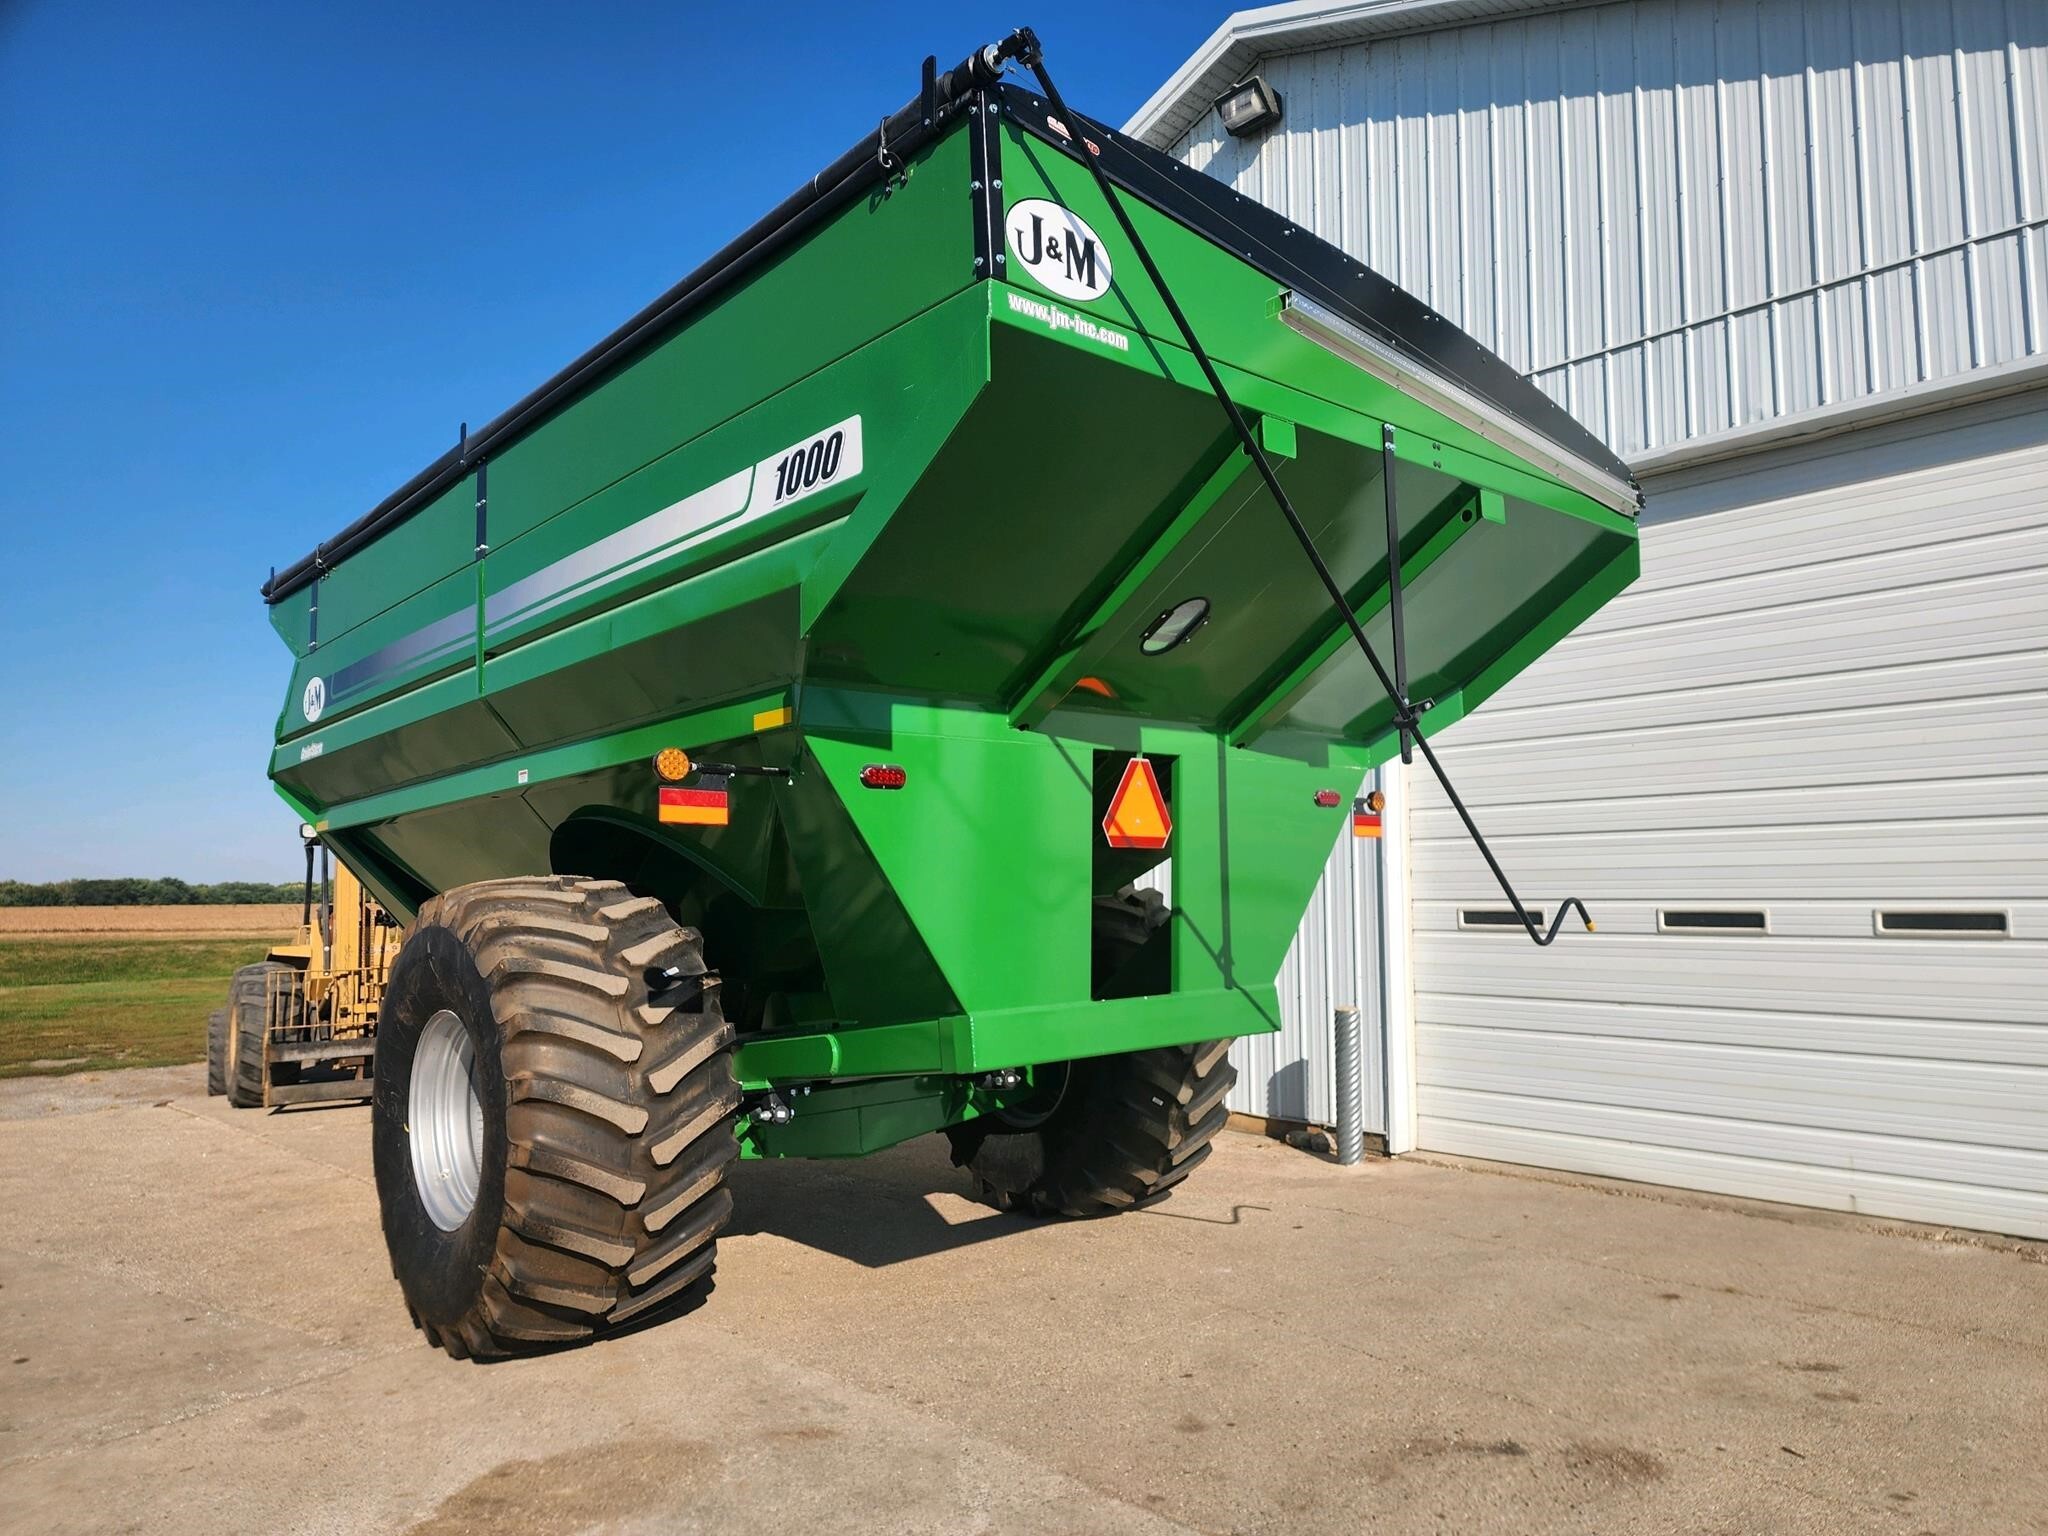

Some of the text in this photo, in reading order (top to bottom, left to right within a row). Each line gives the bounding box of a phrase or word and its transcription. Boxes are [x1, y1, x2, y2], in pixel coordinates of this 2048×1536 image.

[1015, 212, 1098, 290] J&M
[1007, 292, 1129, 351] www.jm-inc.com
[775, 430, 843, 501] 1000
